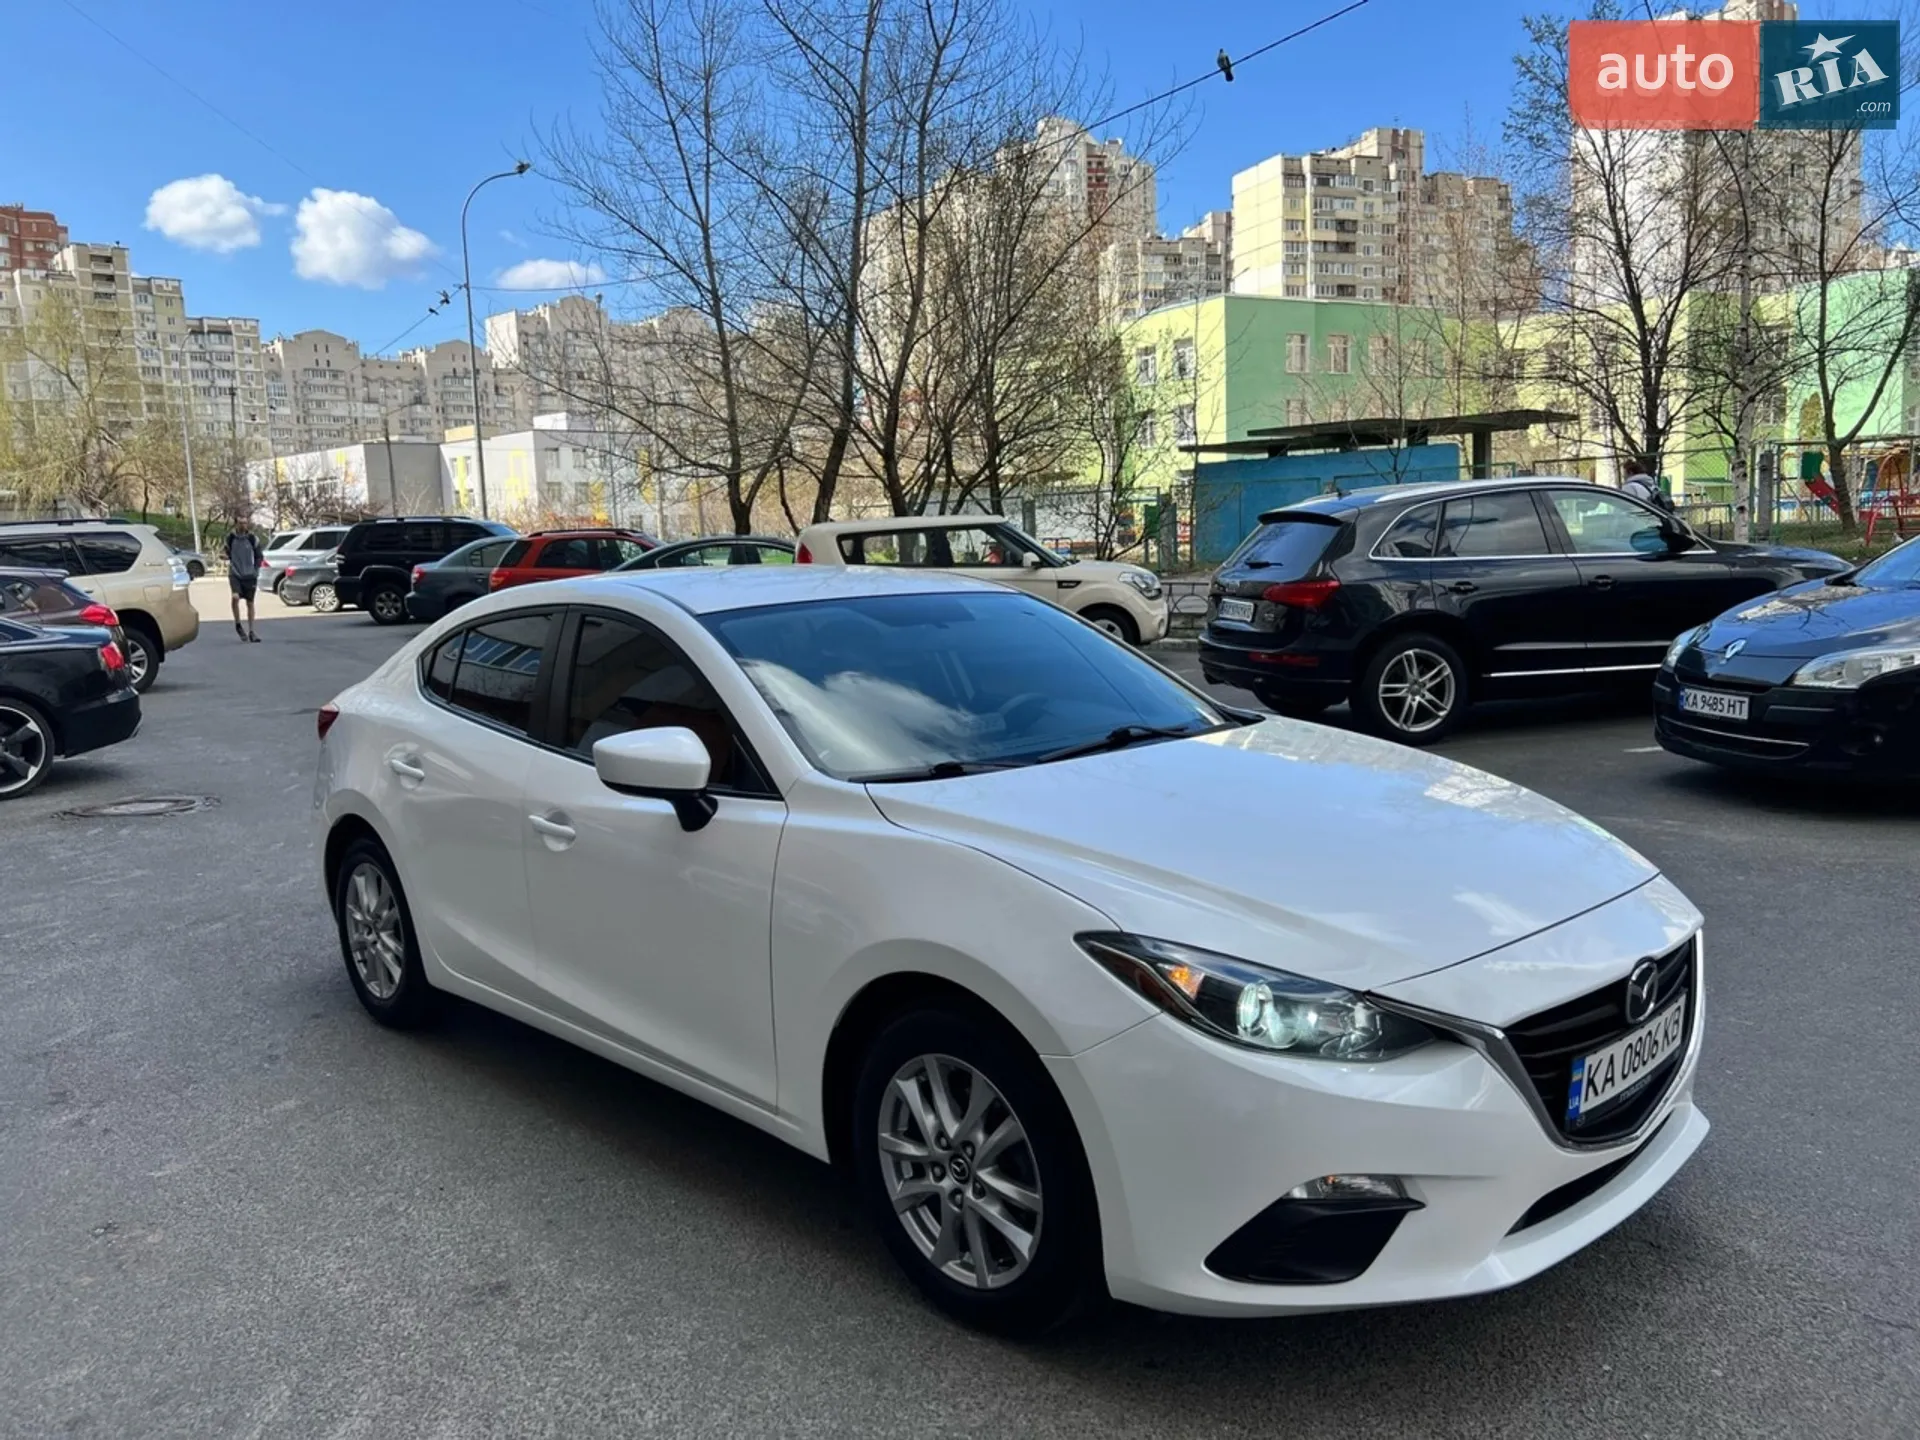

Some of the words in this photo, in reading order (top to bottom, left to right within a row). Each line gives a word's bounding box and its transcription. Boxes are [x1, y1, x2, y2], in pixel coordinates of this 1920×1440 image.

[1684, 692, 1698, 708] KA
[1700, 694, 1725, 712] 9485
[1726, 698, 1747, 716] HT
[1585, 1053, 1616, 1102] KA
[1622, 1022, 1661, 1080] 0806
[1661, 1005, 1681, 1052] KB
